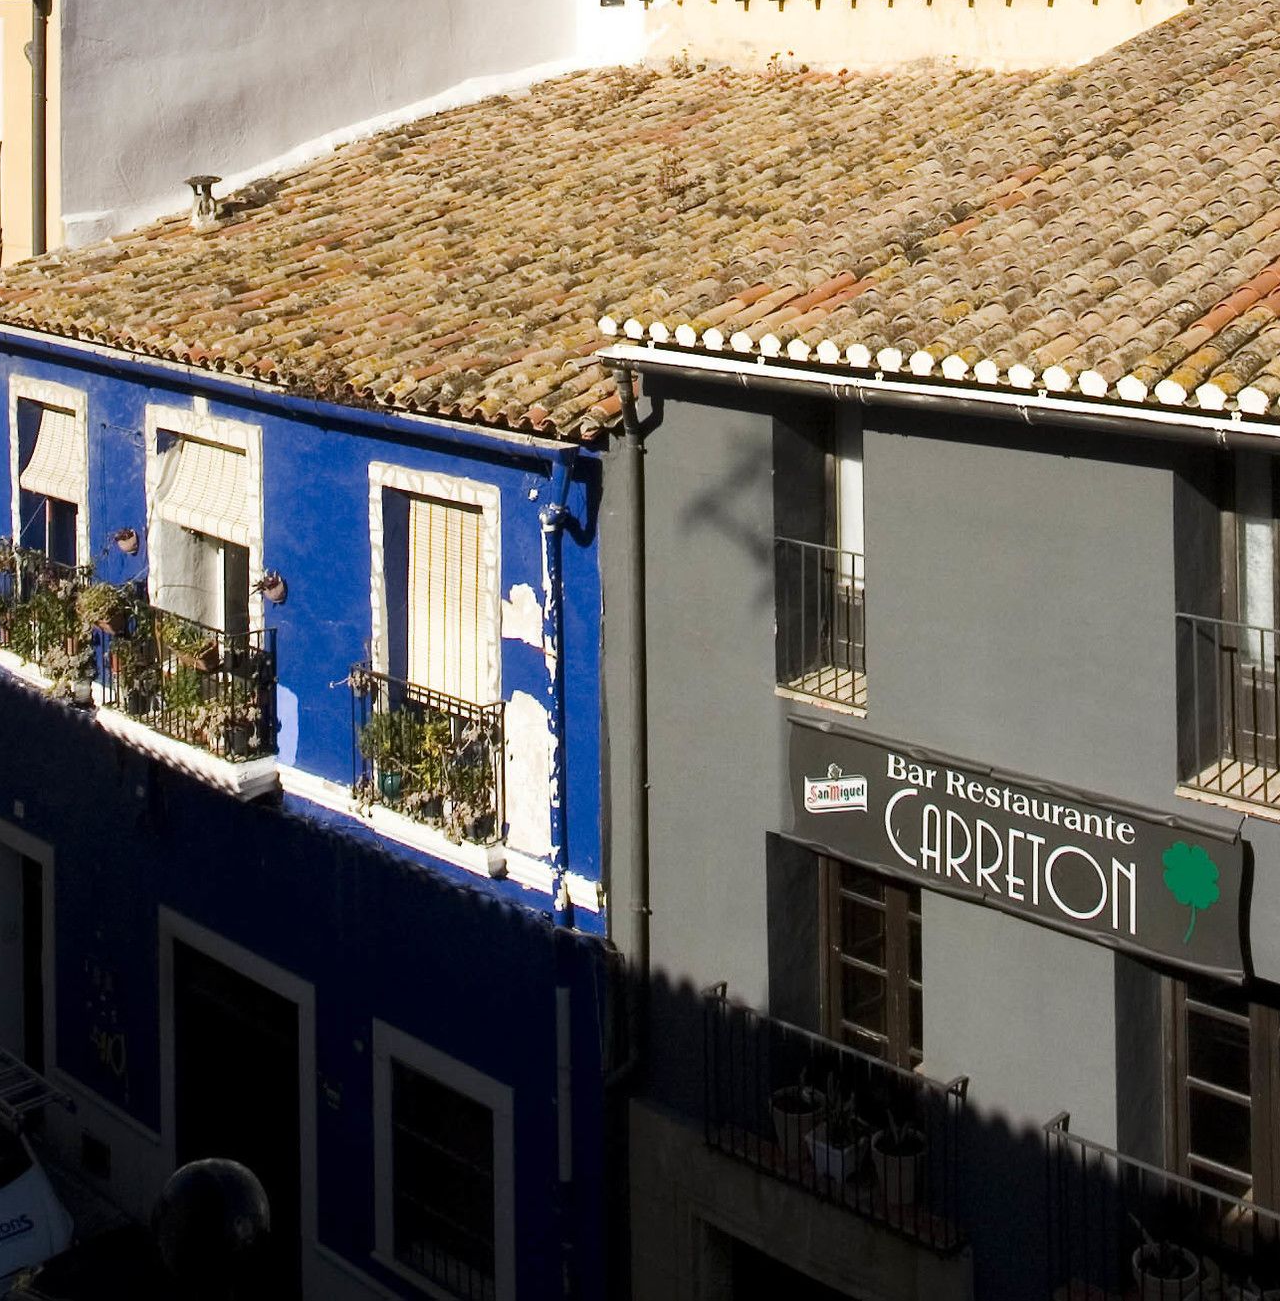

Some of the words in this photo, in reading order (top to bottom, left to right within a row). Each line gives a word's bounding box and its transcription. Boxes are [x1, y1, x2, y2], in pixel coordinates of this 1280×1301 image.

[886, 753, 937, 789] Bar
[946, 769, 1136, 844] Restaurante
[884, 788, 1137, 936] CARRETON
